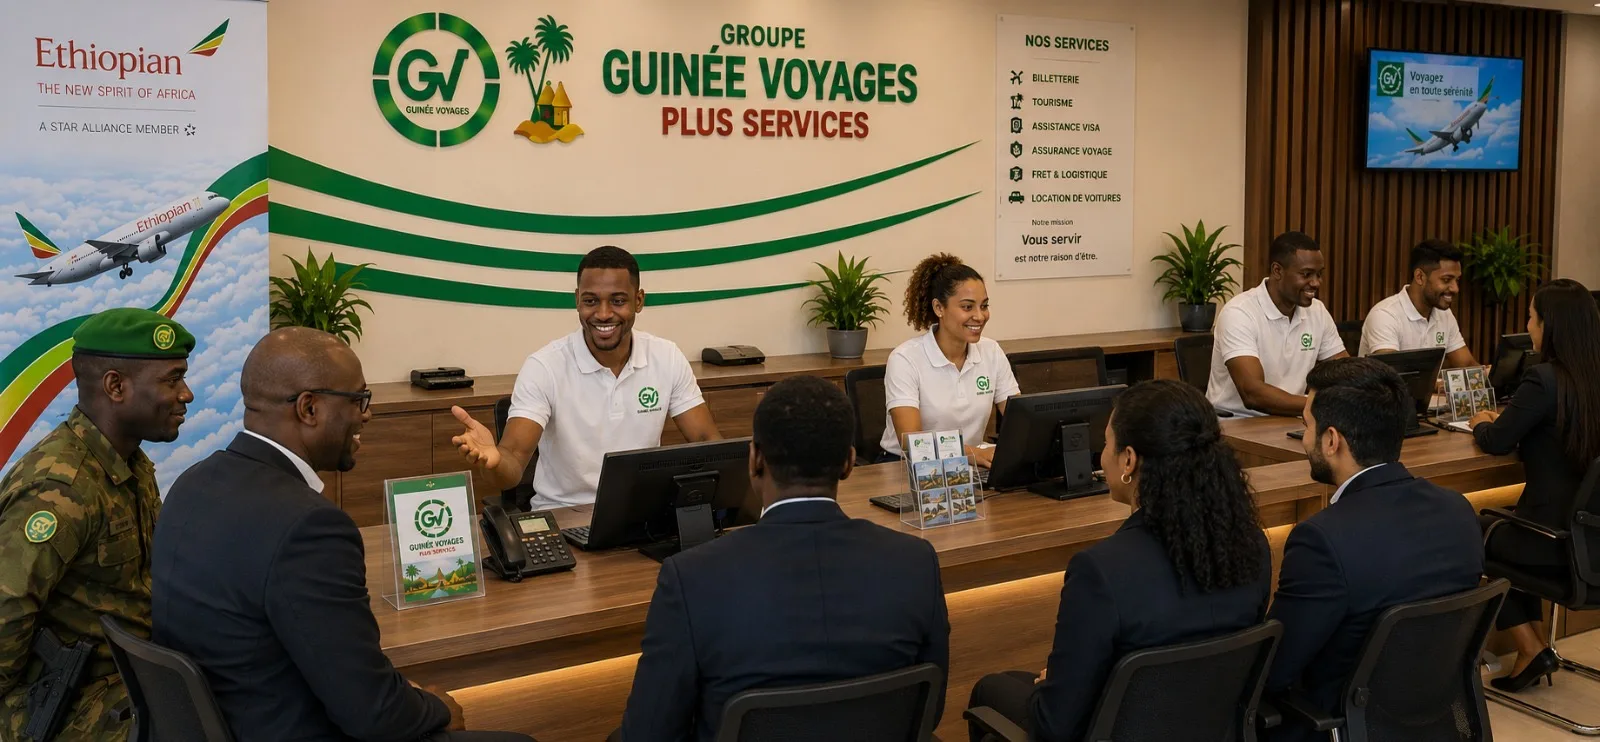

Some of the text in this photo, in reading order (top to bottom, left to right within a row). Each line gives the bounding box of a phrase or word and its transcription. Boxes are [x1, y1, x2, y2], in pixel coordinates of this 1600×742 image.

[720, 23, 805, 48] GROUPE
[1025, 34, 1109, 51] NOS SERVICES
[35, 37, 183, 80] Ethiopian
[397, 49, 470, 102] GV
[602, 45, 918, 103] GUINÉE VOYAGES
[1032, 73, 1080, 84] BILLETTERIE
[1410, 71, 1444, 84] Voyagez
[37, 83, 196, 100] THE NEW SPIRIT OF AFRICA
[1410, 86, 1420, 94] en
[1421, 86, 1442, 95] toute
[1032, 98, 1073, 107] TOURISME
[405, 104, 470, 115] GUINÉE VOYAGES
[39, 122, 179, 134] A STAR ALLIANCE MEMBER
[662, 107, 869, 139] PLUS SERVICES
[1032, 122, 1100, 132] ASSISTANCE VISA
[1032, 146, 1112, 156] ASSURANCE VOYAGE
[1032, 170, 1108, 180] FRET & LOGISTIQUE
[1031, 194, 1121, 203] LOCATION DE VOITURES
[136, 202, 192, 232] Ethiopian
[1022, 233, 1082, 245] Vous servir
[1014, 254, 1027, 263] est
[1028, 253, 1049, 262] notre
[1050, 252, 1073, 261] raison
[421, 507, 445, 528] GV
[435, 537, 464, 547] VOYAGES
